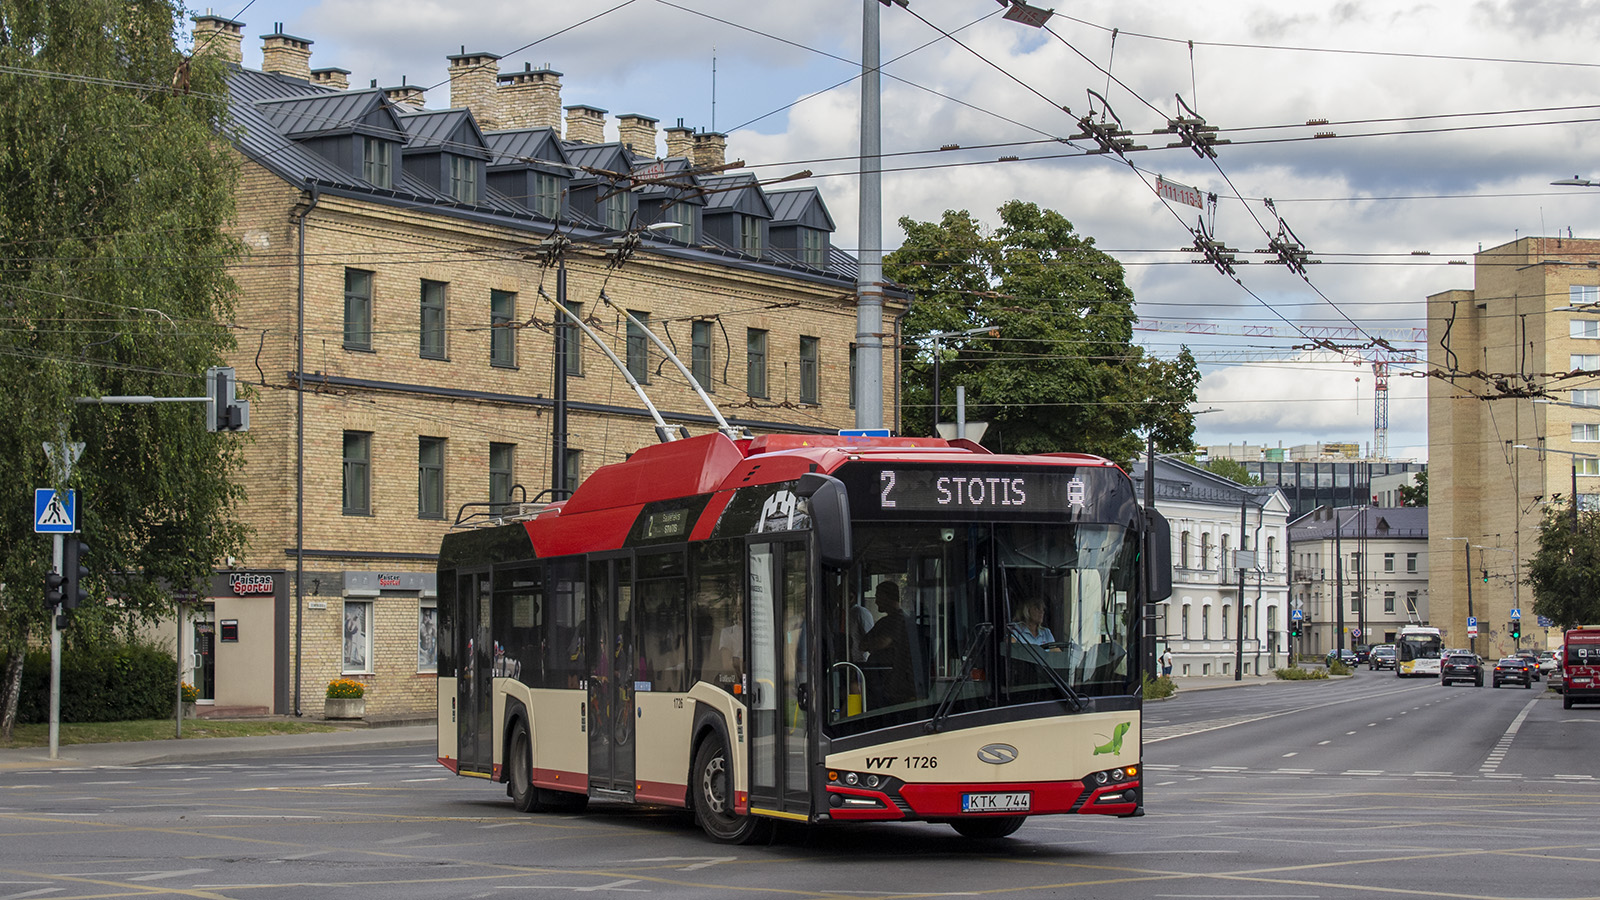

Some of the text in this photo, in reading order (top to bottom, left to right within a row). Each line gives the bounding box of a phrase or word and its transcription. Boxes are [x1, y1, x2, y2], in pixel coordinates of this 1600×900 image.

[880, 470, 1026, 508] 2 STOTIS
[230, 574, 272, 585] Maistas
[234, 581, 273, 595] Sportui
[673, 698, 684, 709] 1726
[865, 756, 938, 769] VVT 1726
[970, 795, 997, 808] KTK
[1005, 795, 1028, 807] 744
